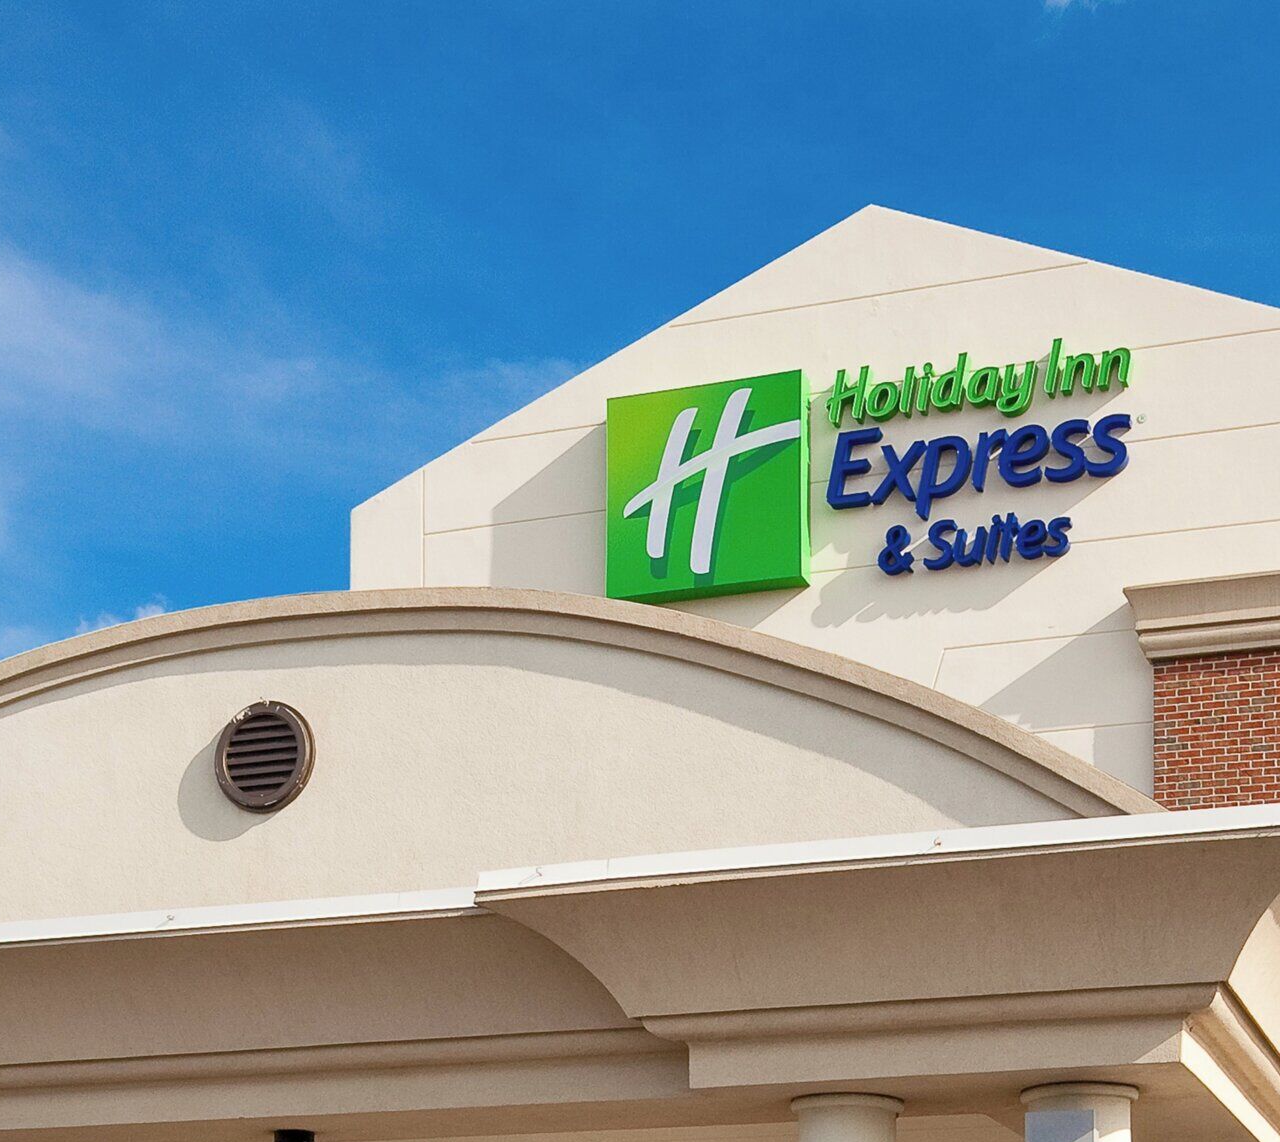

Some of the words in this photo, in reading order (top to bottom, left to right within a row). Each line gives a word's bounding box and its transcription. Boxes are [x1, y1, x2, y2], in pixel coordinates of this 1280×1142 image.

[825, 352, 1037, 427] Holiday
[1044, 338, 1131, 398] Inn
[826, 413, 1131, 521] Express
[877, 524, 915, 576] &
[923, 512, 1072, 571] Suites
